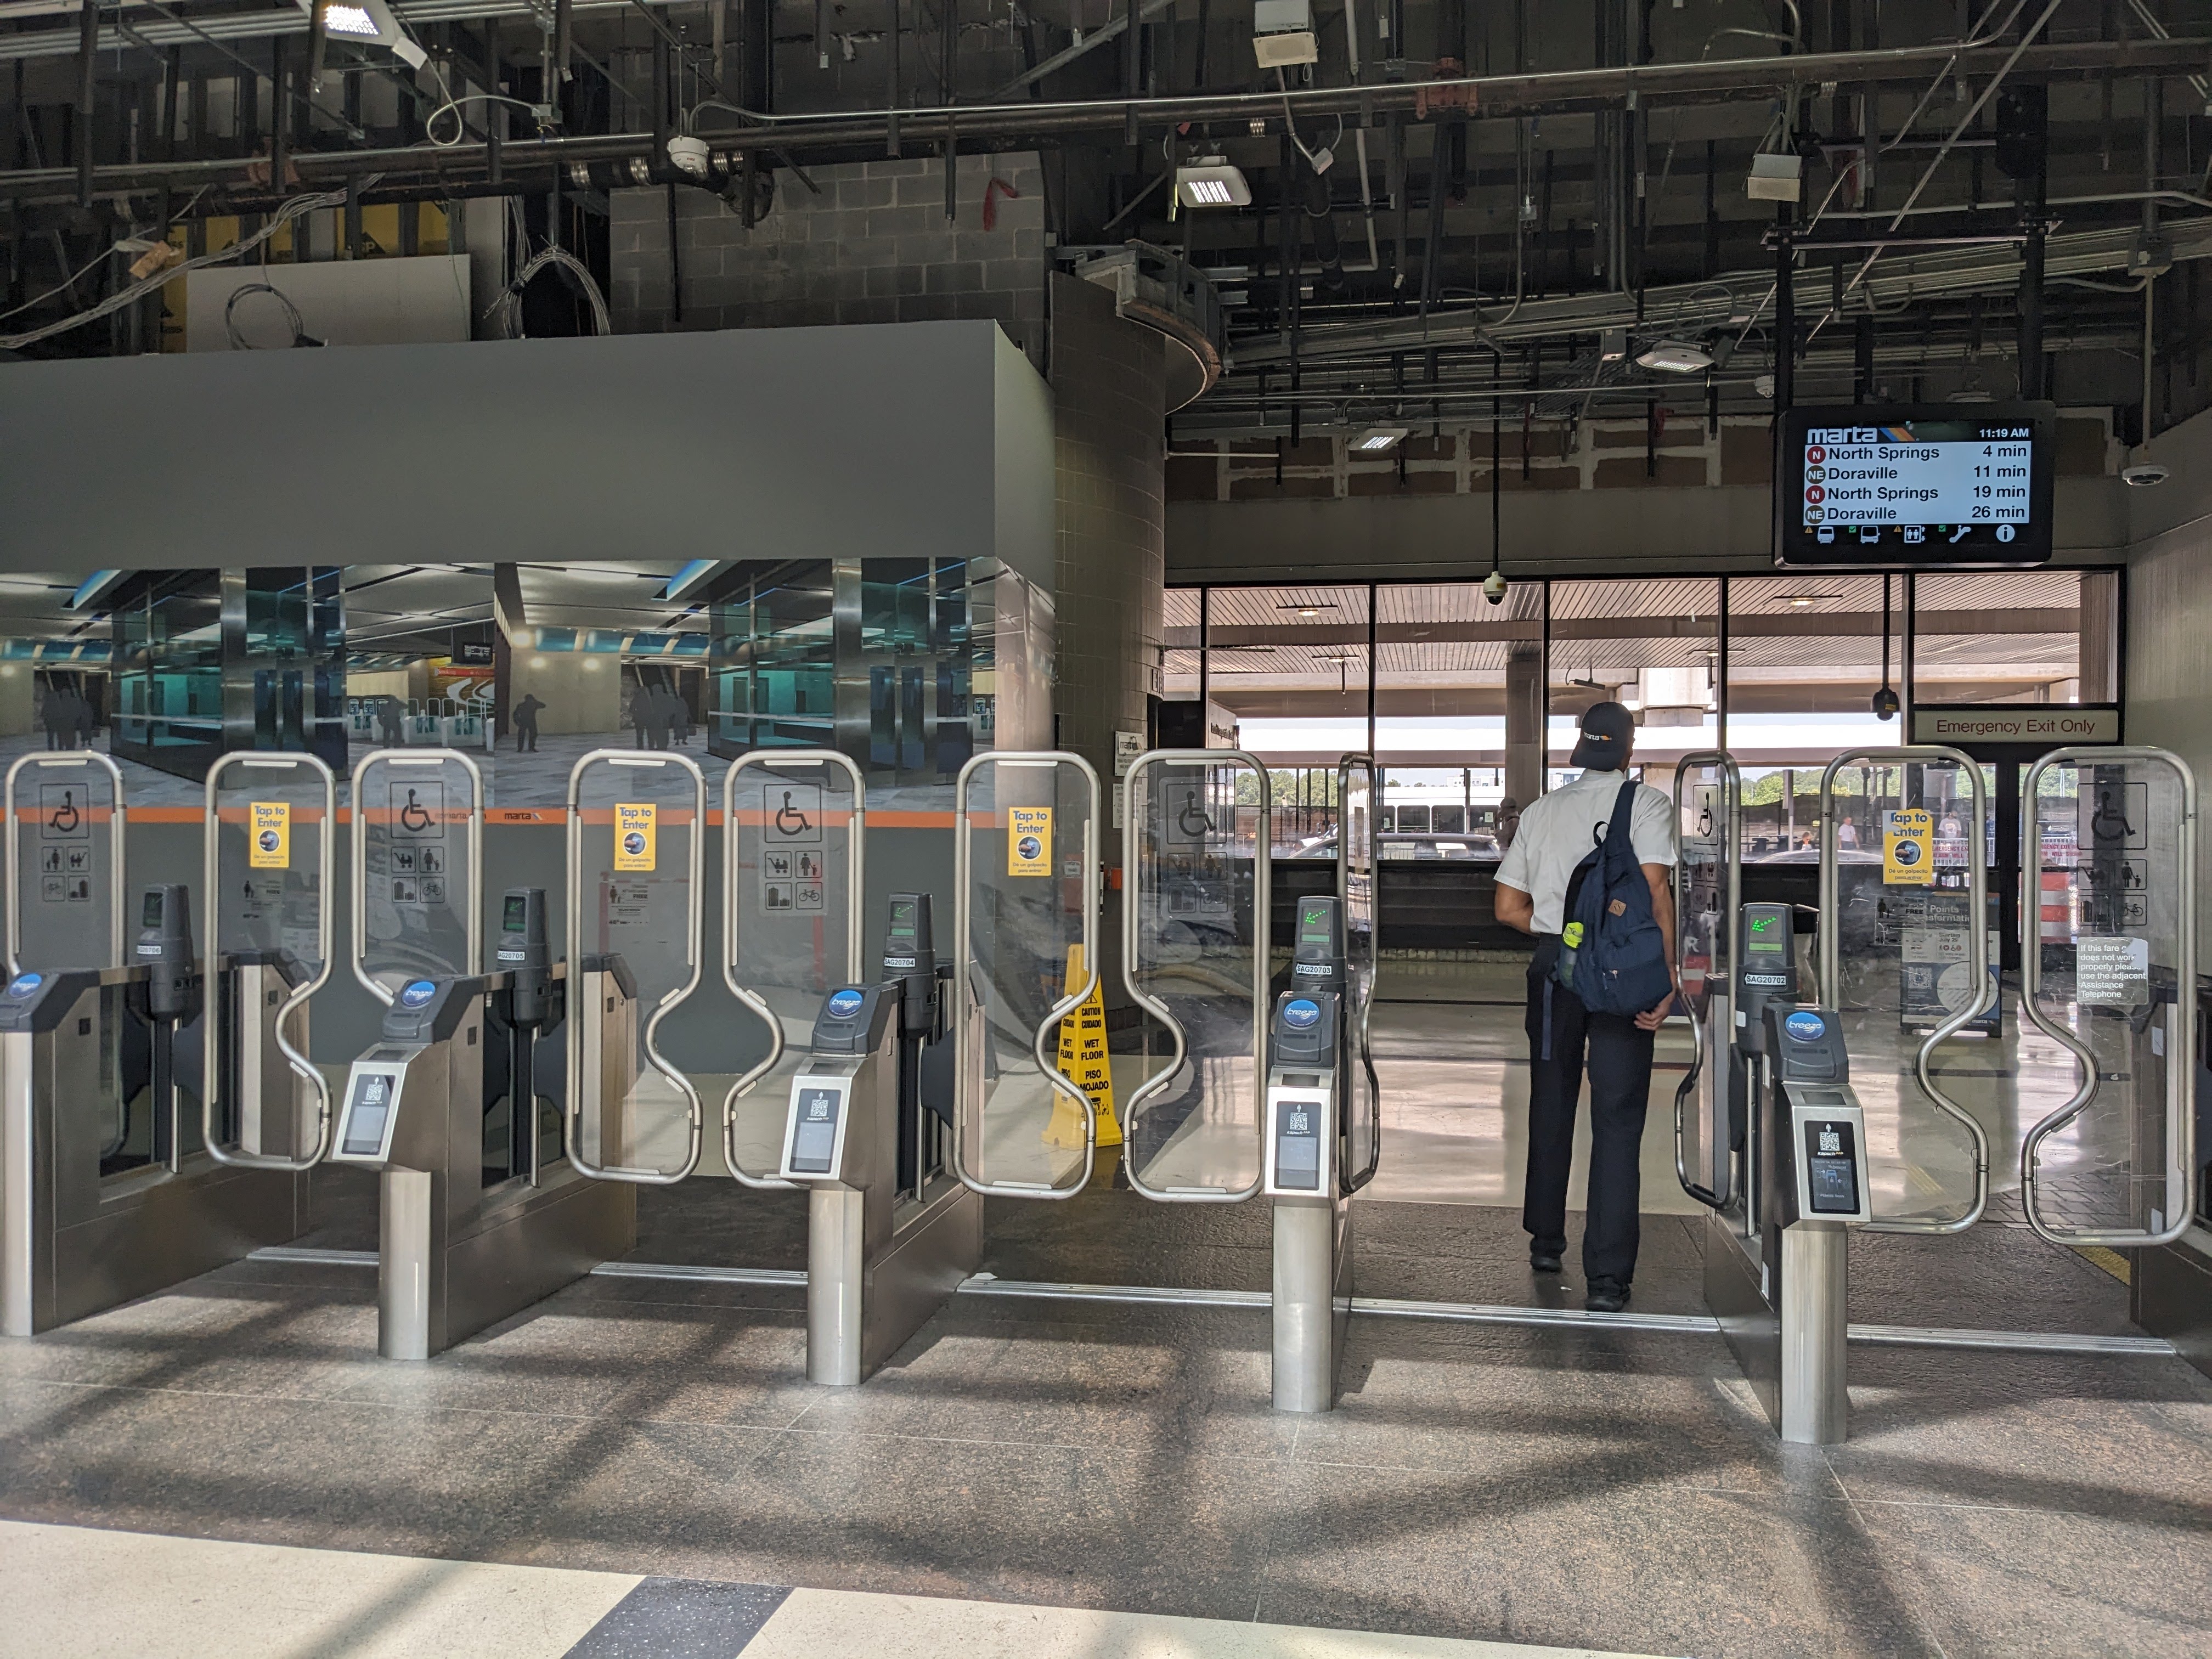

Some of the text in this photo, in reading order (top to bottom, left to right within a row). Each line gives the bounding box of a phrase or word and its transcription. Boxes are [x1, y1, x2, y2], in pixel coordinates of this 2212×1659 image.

[1808, 427, 1877, 443] marta
[1979, 428, 2029, 438] 11:19 AM
[1812, 445, 2027, 461] N North Springs 4 min
[1808, 465, 2026, 479] NE Doraville 11 min
[1811, 486, 2025, 501] N North Springs 19 min
[1807, 505, 2025, 520] NE Doraville 26 min
[1937, 719, 2095, 735] Emergency Exit Only
[255, 806, 272, 817] Tap
[619, 807, 638, 819] Tap
[1013, 811, 1047, 822] Tap to
[258, 817, 283, 827] Enter
[1915, 813, 1928, 822] to
[623, 820, 649, 829] Enter
[1017, 823, 1045, 833] Enter
[1930, 905, 1959, 913] Points
[1297, 966, 1330, 974] SAG20703
[1746, 975, 1785, 984] SAG20702
[2112, 972, 2146, 980] adjacent
[1082, 1007, 1101, 1016] CAUTION
[1081, 1019, 1102, 1029] CUIDADO
[1788, 1020, 1821, 1029] breeze
[1063, 1038, 1072, 1047] WET
[1084, 1039, 1099, 1048] WET
[1060, 1049, 1074, 1060] FLOOR
[1081, 1051, 1104, 1060] FLOOR
[1085, 1069, 1101, 1080] PISO
[1080, 1080, 1109, 1092] MOJADO
